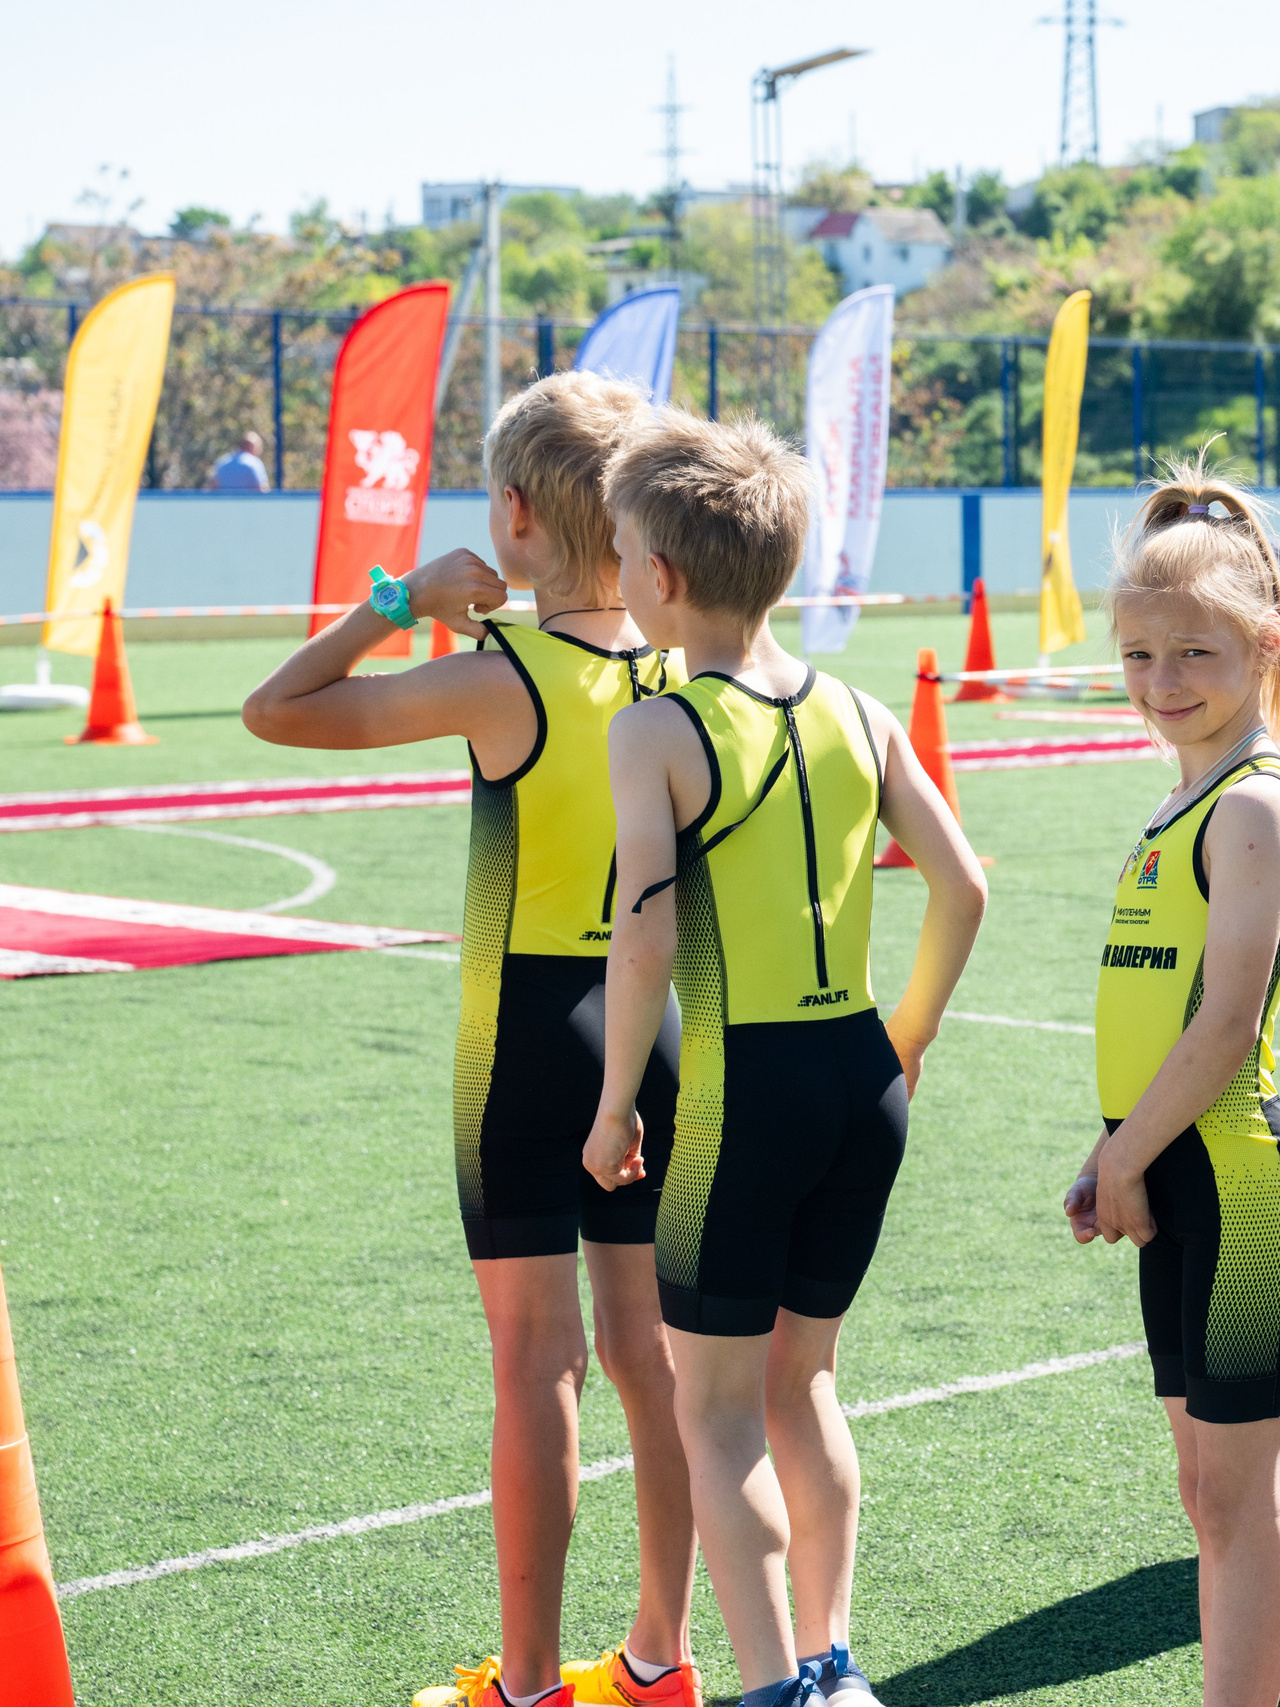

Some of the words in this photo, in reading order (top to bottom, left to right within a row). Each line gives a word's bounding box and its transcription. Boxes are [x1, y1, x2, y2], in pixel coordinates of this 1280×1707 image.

[582, 931, 611, 941] FANL
[1110, 945, 1178, 970] ВАЛЕРИЯ
[800, 990, 849, 1007] FANLIFE
